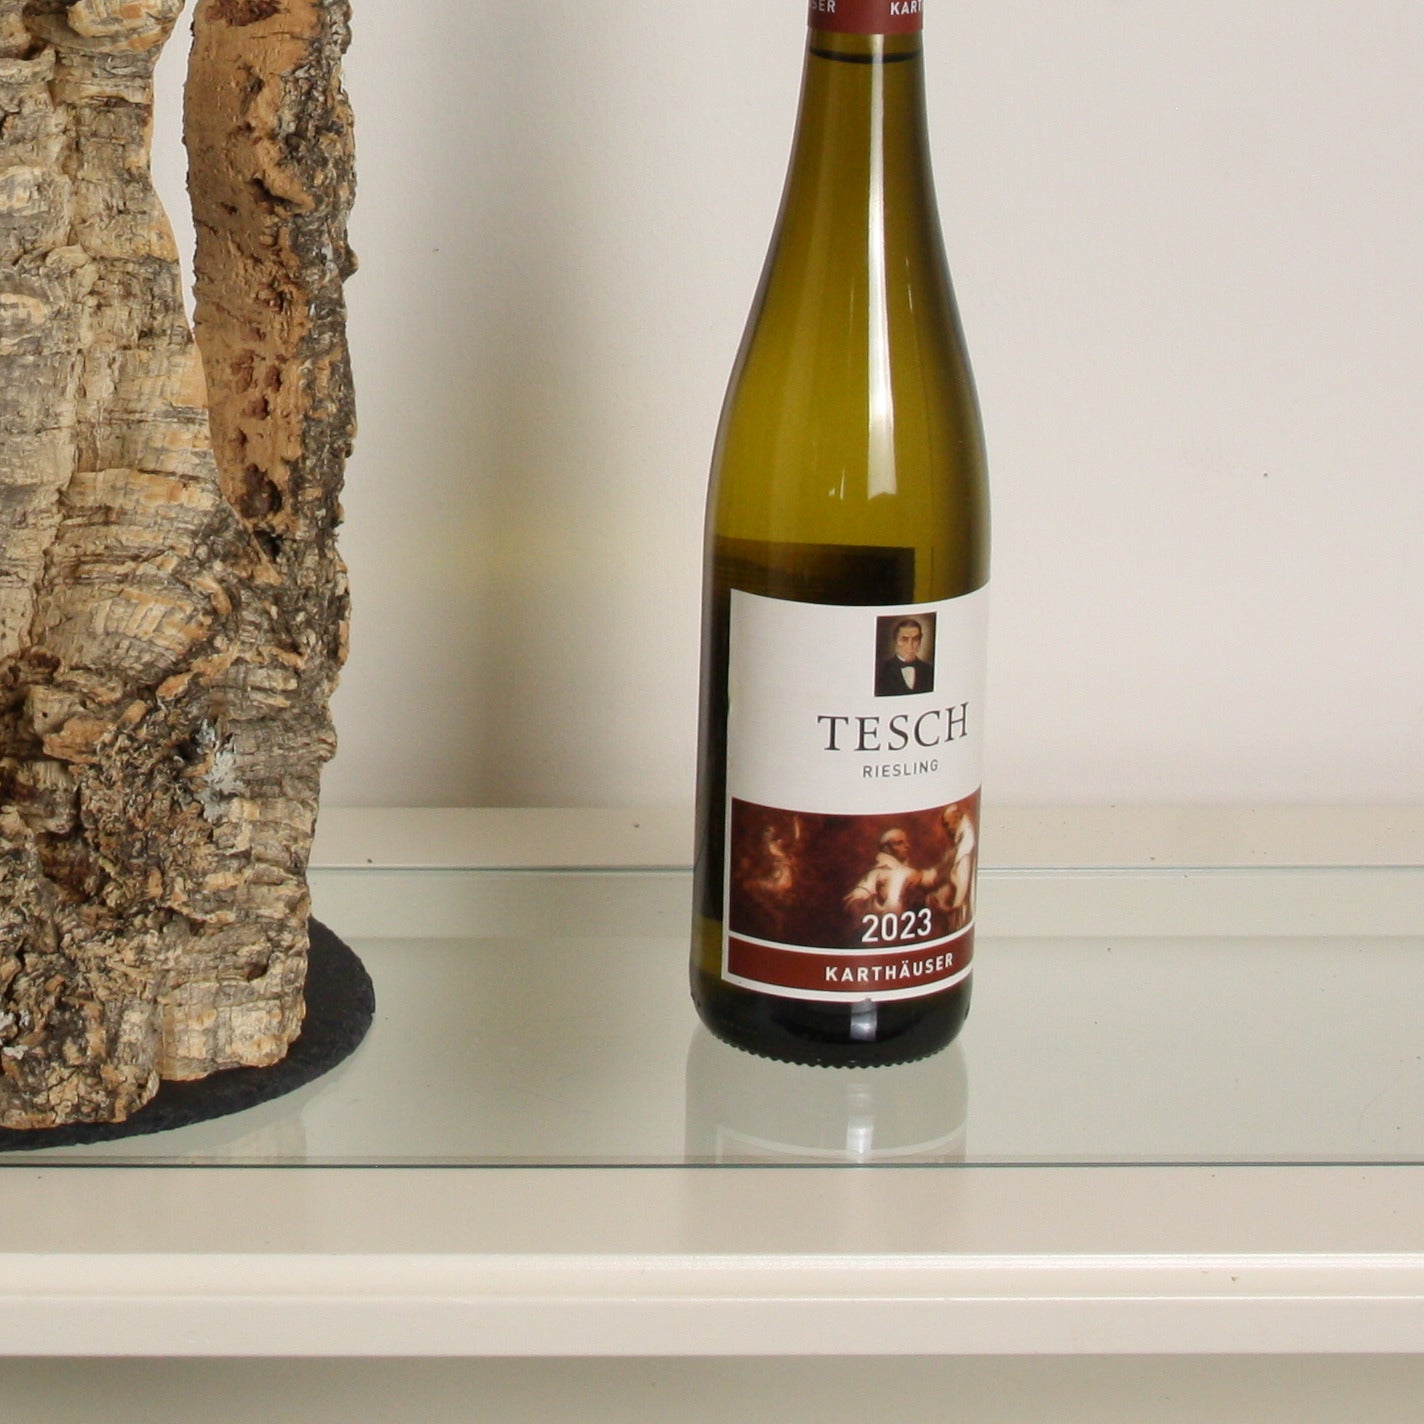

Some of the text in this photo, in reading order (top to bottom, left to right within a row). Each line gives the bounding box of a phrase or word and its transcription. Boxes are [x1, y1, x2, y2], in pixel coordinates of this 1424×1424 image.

[817, 701, 970, 752] TESCH
[862, 759, 939, 779] RIESLING
[861, 908, 933, 943] 2023
[825, 952, 954, 982] KARTHÄUSER
